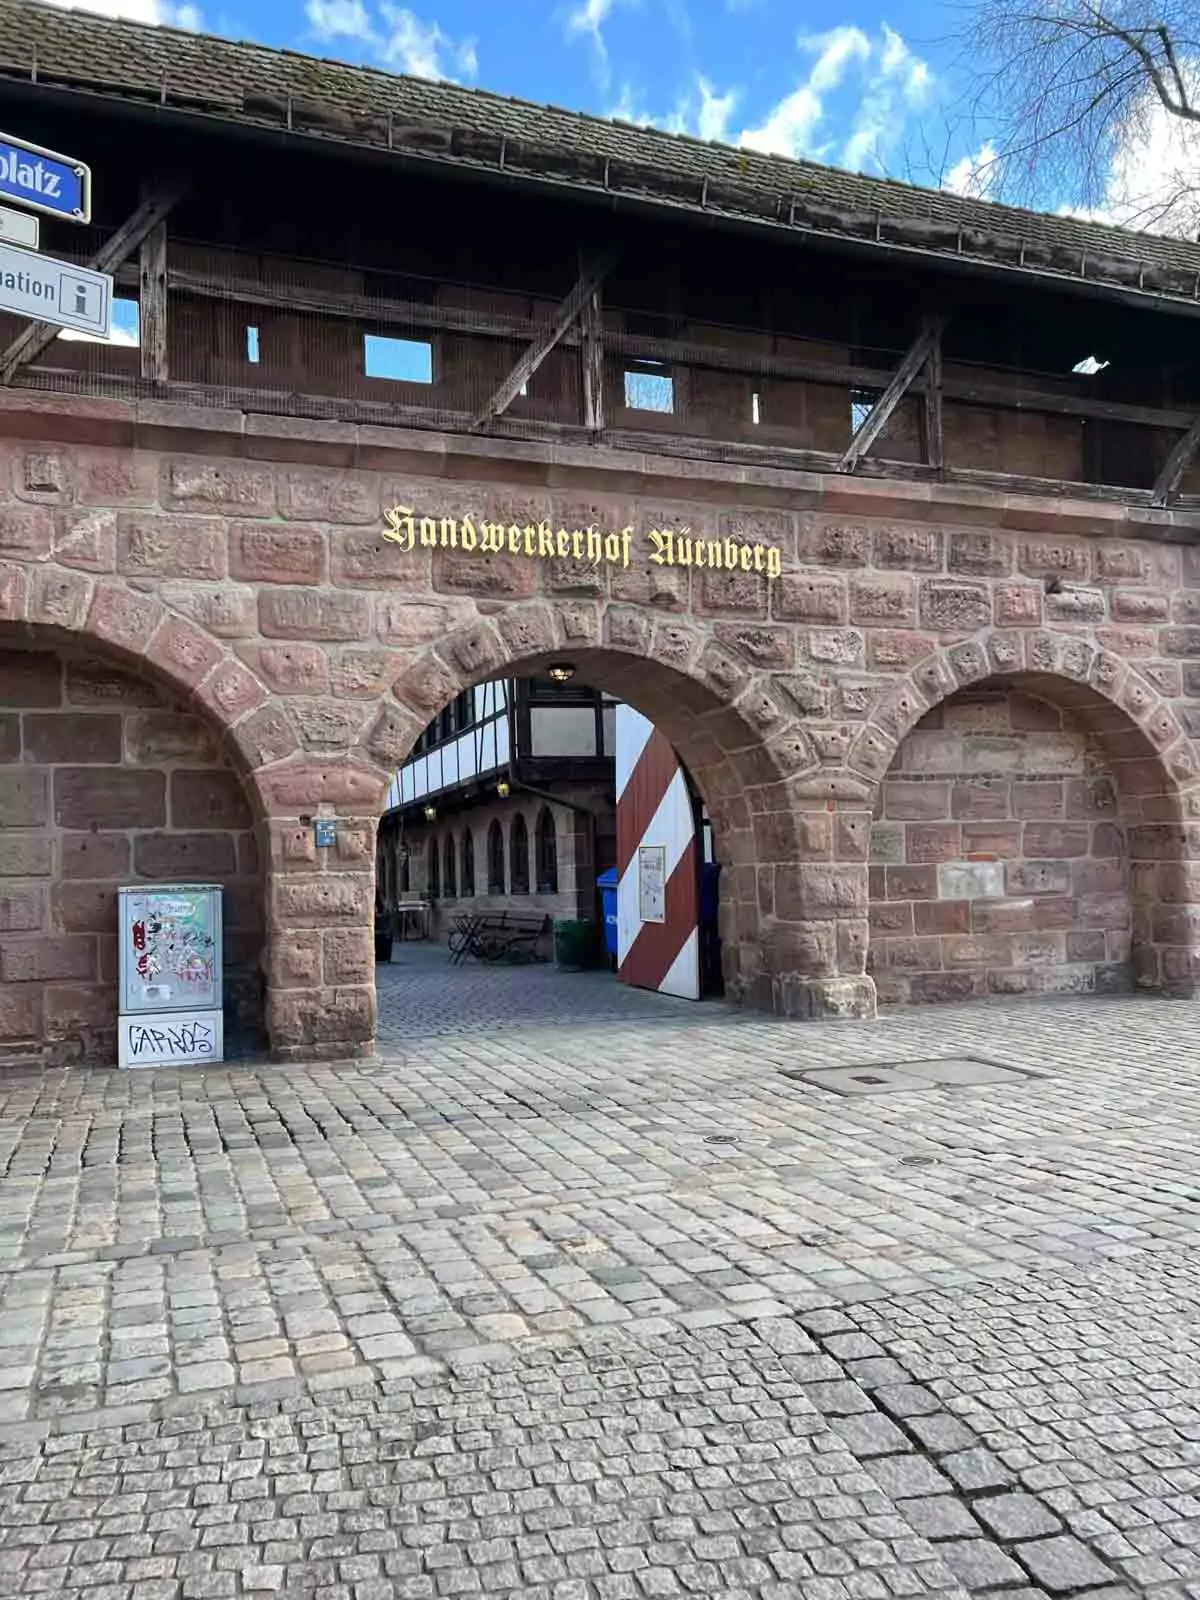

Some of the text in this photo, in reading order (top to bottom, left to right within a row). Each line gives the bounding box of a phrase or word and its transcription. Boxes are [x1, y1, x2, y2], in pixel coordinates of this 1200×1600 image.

[0, 271, 55, 301] ation
[382, 504, 781, 578] Handwerkerhof Nürnberg
